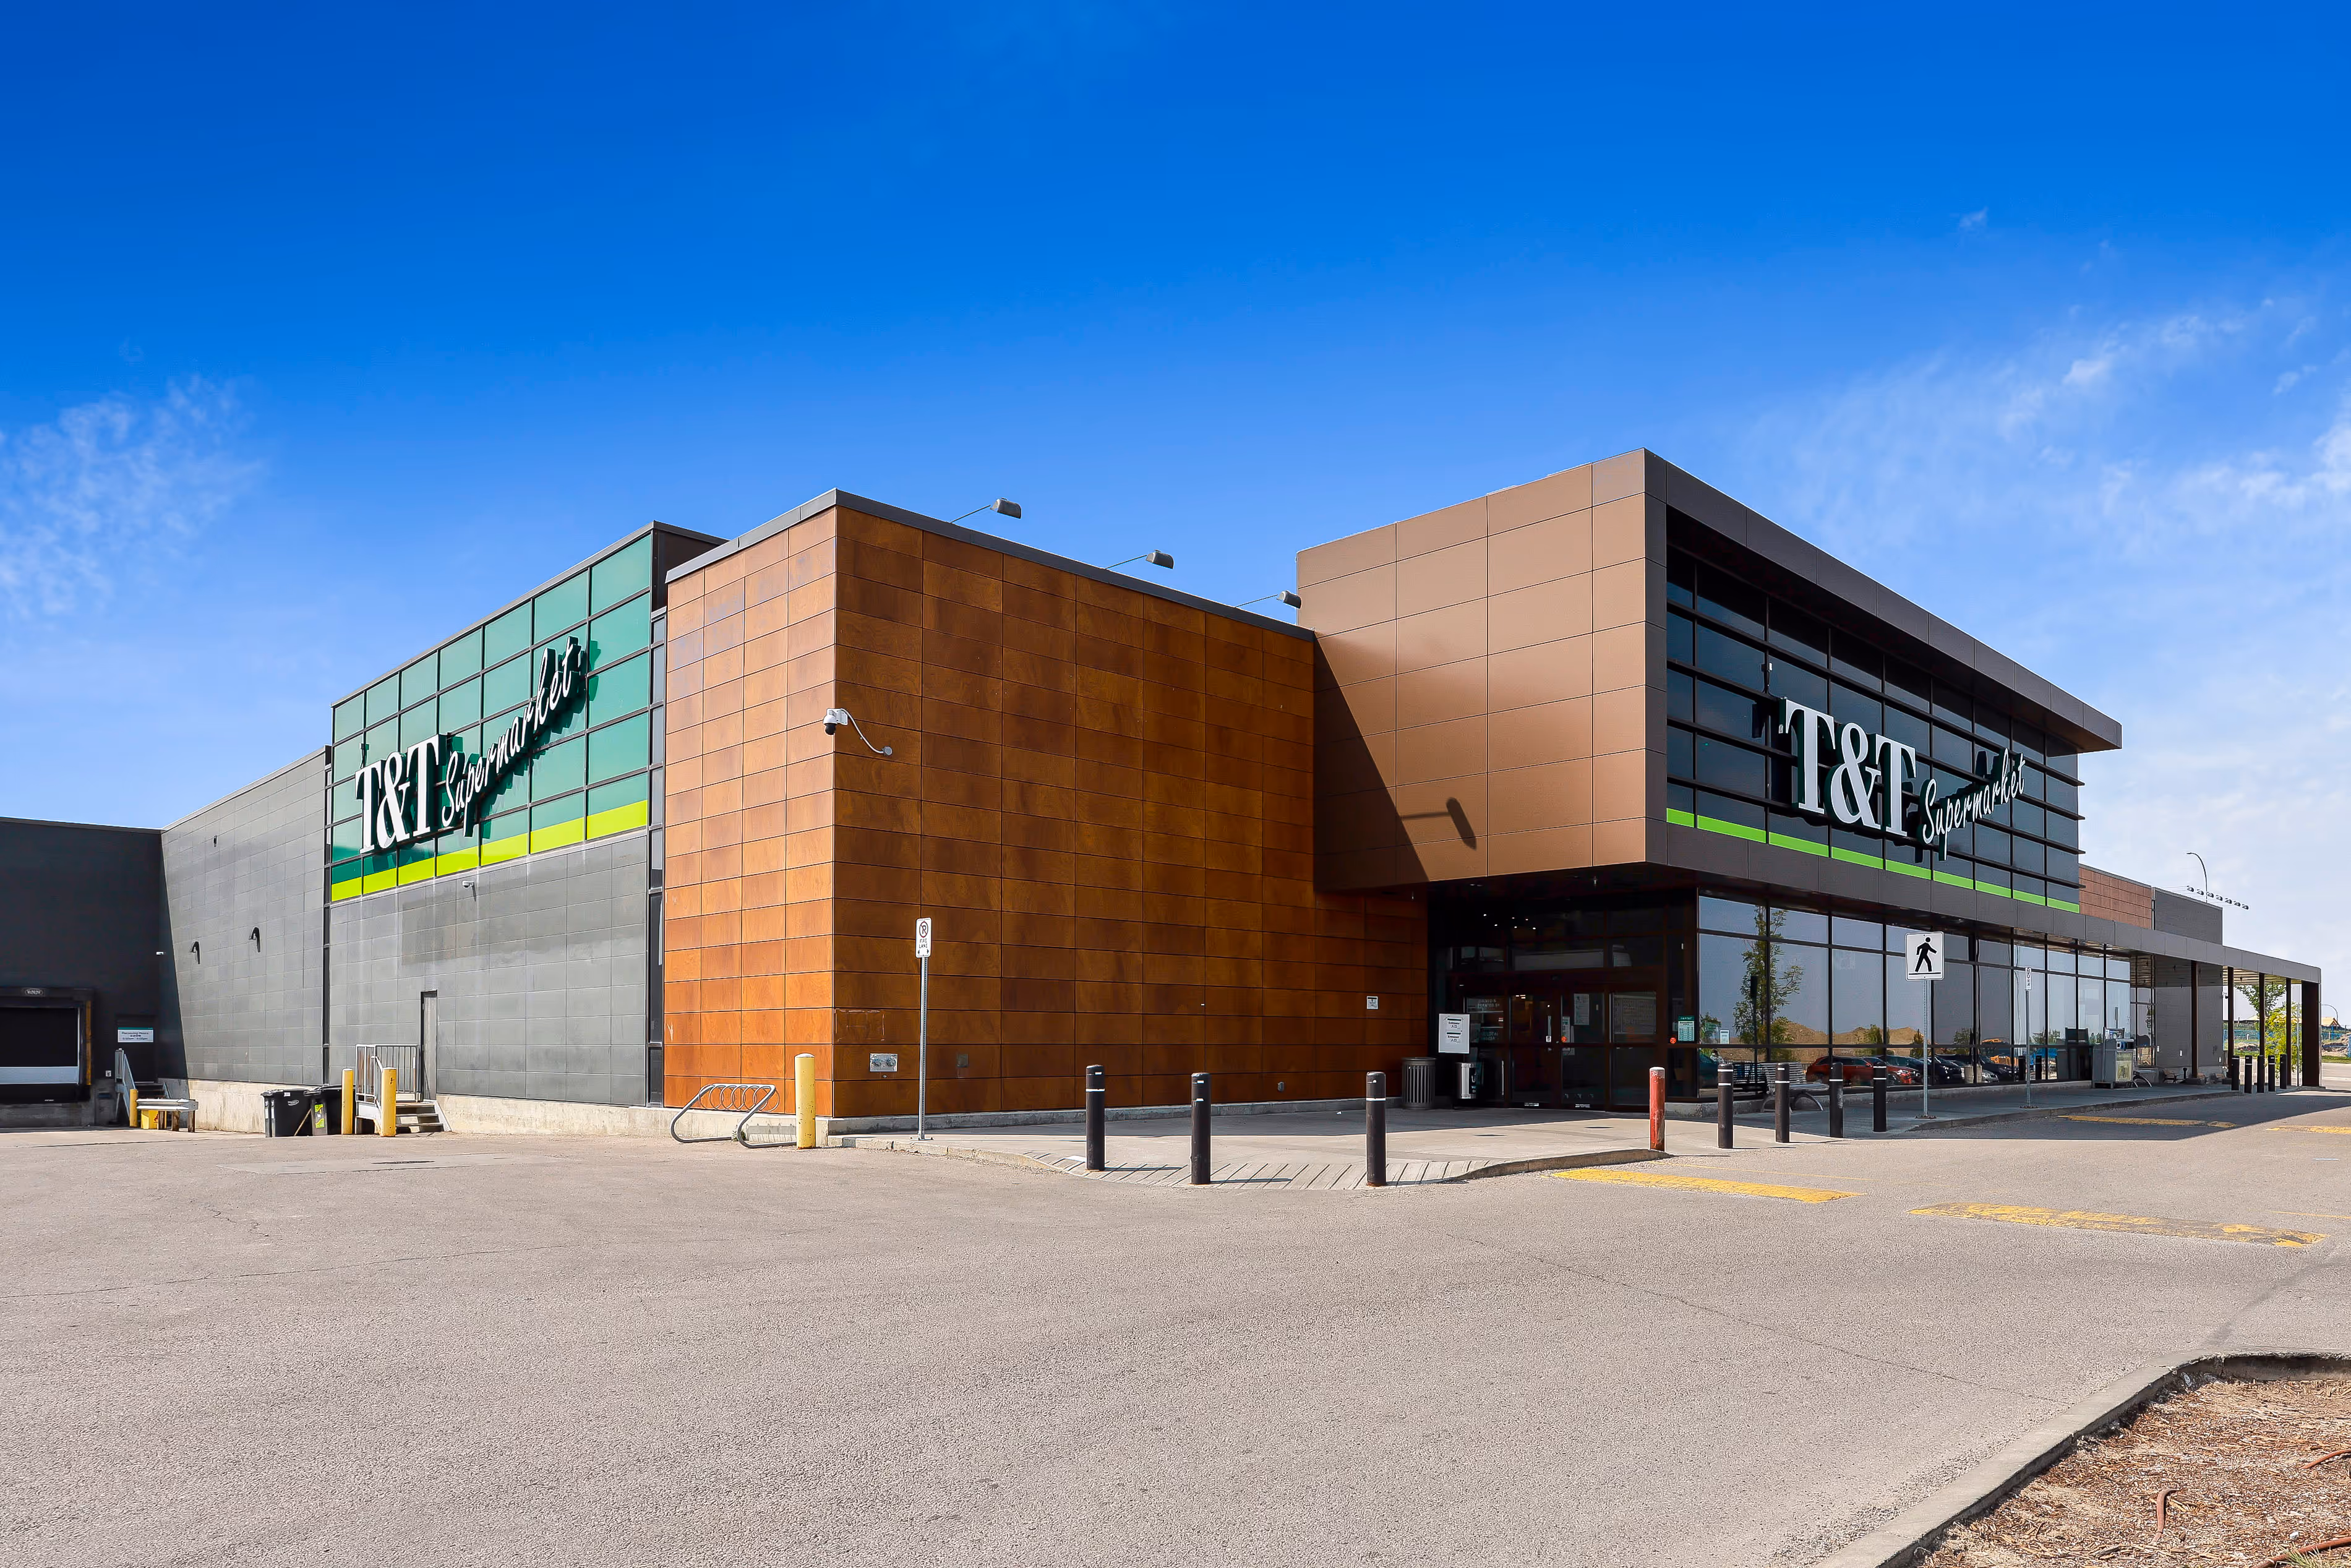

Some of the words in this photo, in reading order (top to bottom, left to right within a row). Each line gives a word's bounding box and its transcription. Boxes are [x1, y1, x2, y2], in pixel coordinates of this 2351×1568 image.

[355, 734, 440, 854] T&T
[442, 636, 582, 837] Supermarket
[1785, 698, 1917, 837] T&T
[1922, 748, 2026, 861] Supermarket
